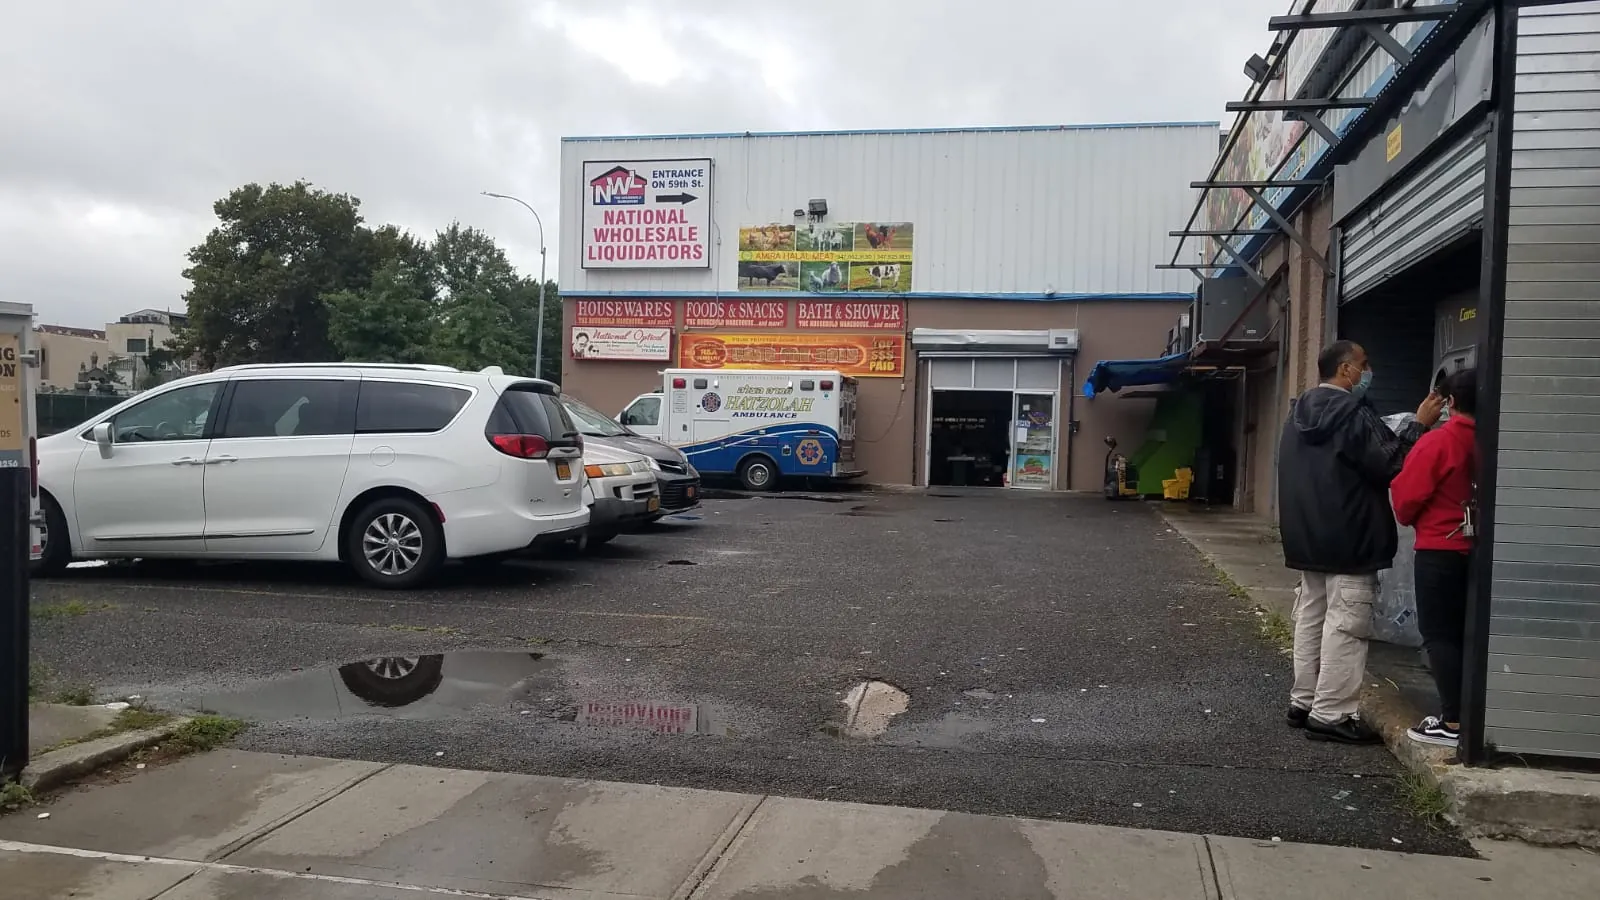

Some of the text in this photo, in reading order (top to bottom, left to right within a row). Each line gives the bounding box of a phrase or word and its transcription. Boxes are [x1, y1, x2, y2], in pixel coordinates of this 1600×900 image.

[652, 169, 704, 178] ENTRANCE
[594, 169, 643, 204] NWL
[652, 179, 704, 189] ON 59th St.
[604, 209, 688, 225] NATIONAL
[593, 226, 698, 242] WHOLESALE
[588, 244, 703, 262] LIQUIDATORS
[755, 252, 781, 260] AMIRA
[783, 252, 810, 260] HALAL
[811, 252, 833, 260] MEAT
[578, 301, 672, 317] HOUSEWARES
[686, 302, 784, 318] FOODS & SNACKS
[799, 303, 900, 320] BATH & SHOWER
[592, 329, 667, 344] National Optical
[869, 361, 895, 371] PAID
[724, 395, 816, 412] HATZOLAH
